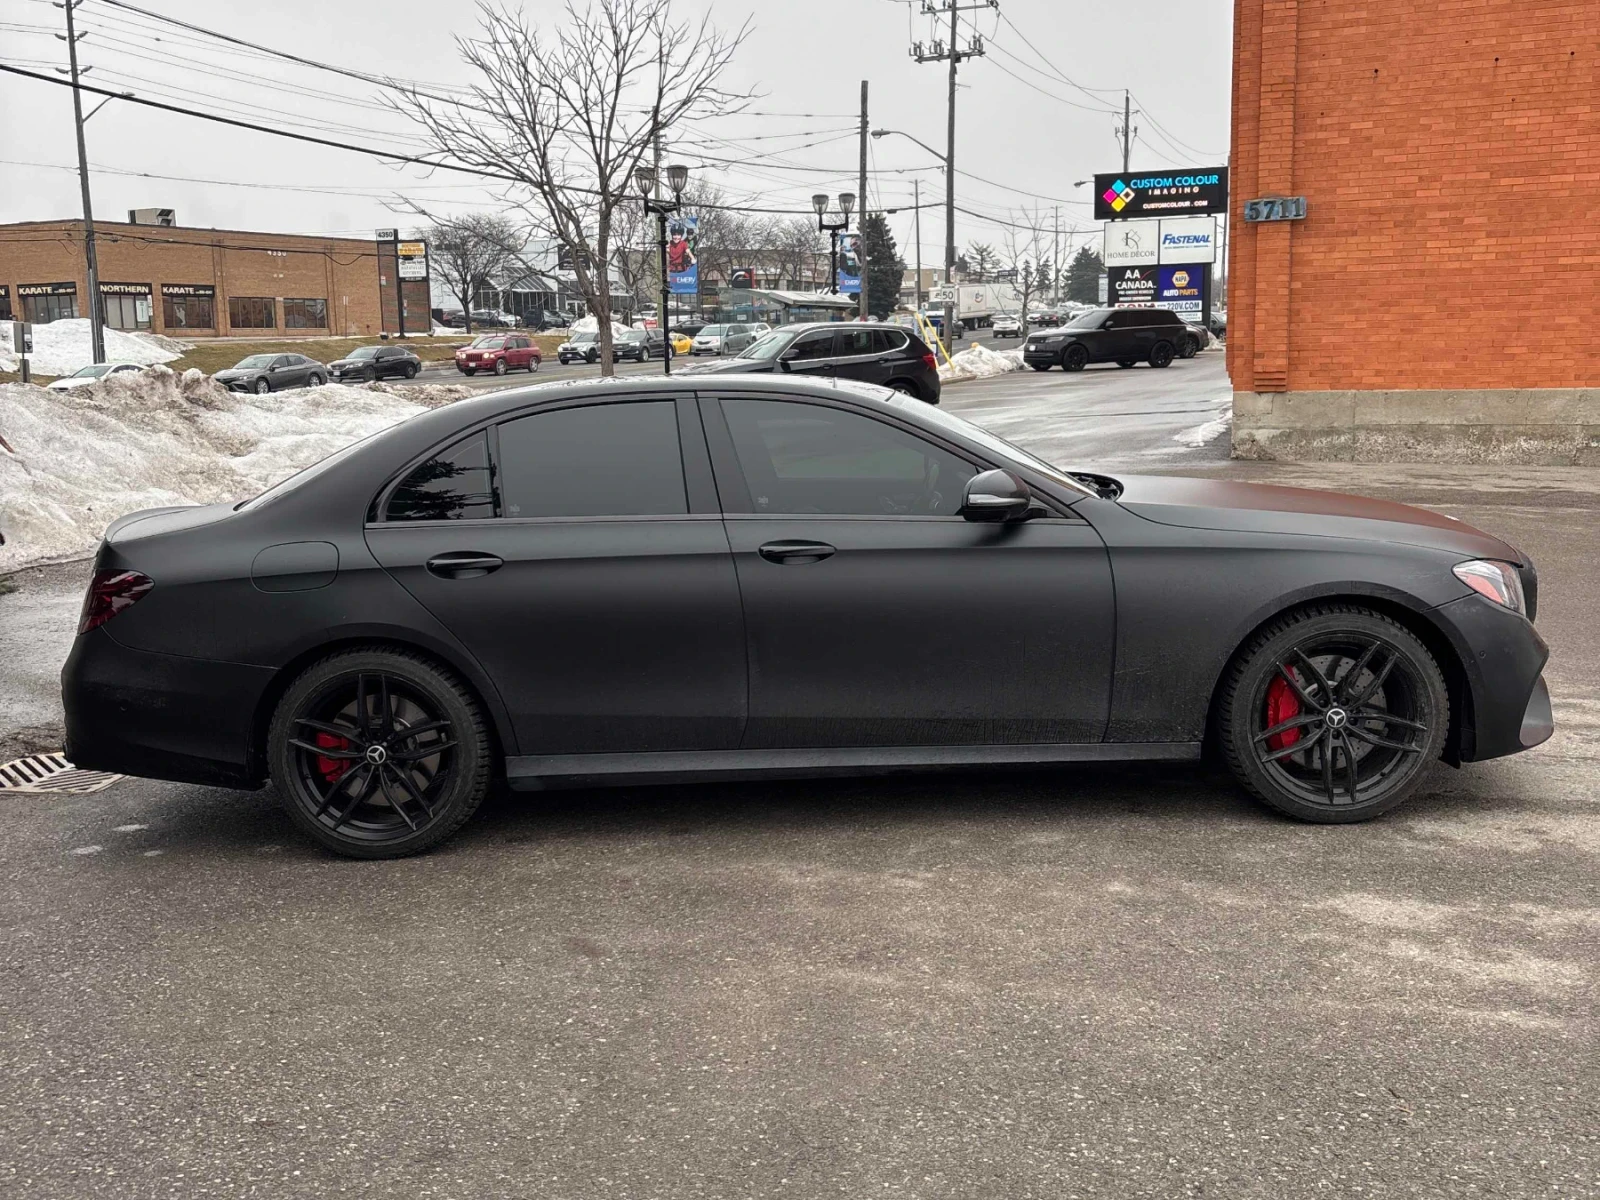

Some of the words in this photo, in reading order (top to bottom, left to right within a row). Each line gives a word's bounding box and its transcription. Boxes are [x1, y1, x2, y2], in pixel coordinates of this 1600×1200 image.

[1130, 178, 1172, 189] CUSTOM
[1175, 175, 1219, 186] COLOUR
[1148, 186, 1200, 195] IMAGING
[1249, 198, 1303, 220] 5711
[1162, 233, 1211, 245] FASTENAL
[1124, 269, 1141, 279] AA
[100, 285, 149, 293] NORTHERN
[1115, 280, 1154, 289] CANADA
[19, 286, 53, 295] KARATE
[162, 286, 195, 294] KARATE
[1163, 289, 1179, 297] AUTO
[1179, 288, 1198, 296] PARTS
[942, 290, 954, 300] 50
[1167, 301, 1200, 310] 220V.COM
